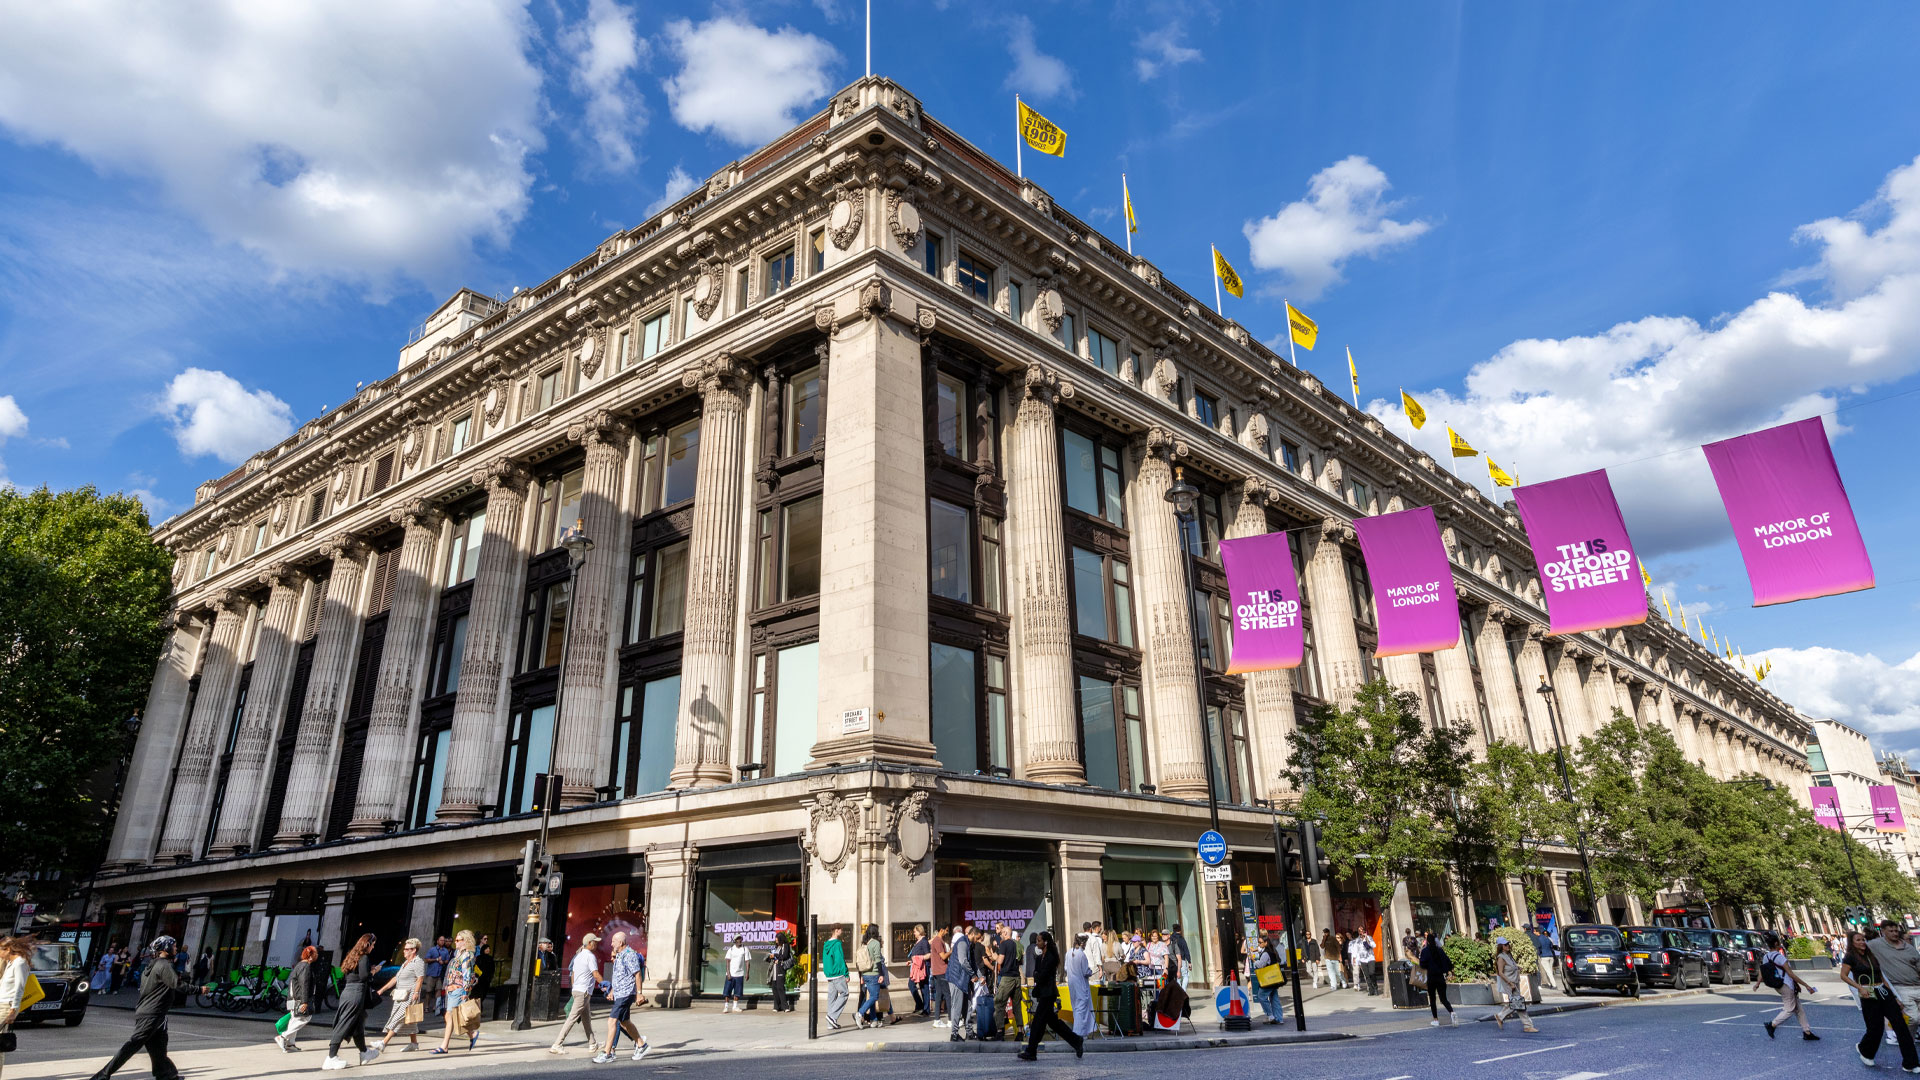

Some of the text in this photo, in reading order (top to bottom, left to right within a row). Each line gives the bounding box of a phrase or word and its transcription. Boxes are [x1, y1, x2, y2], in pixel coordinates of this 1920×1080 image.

[1025, 117, 1058, 135] SINCE
[1024, 126, 1057, 146] 1909
[1753, 512, 1831, 537] MAYOR OF
[1763, 526, 1833, 549] LONDON
[1556, 538, 1607, 561] THIS
[1543, 549, 1631, 578] OXFORD
[1551, 564, 1631, 593] STREET
[1248, 589, 1283, 605] THIS
[1387, 581, 1440, 598] MAYOR OF
[1237, 599, 1299, 618] OXFORD
[1392, 593, 1440, 608] LONDON
[1240, 612, 1297, 630] STREET
[965, 909, 1034, 921] SURROUNDED
[714, 920, 788, 933] SURROUNDED
[975, 920, 990, 931] BY
[723, 931, 736, 943] BY
